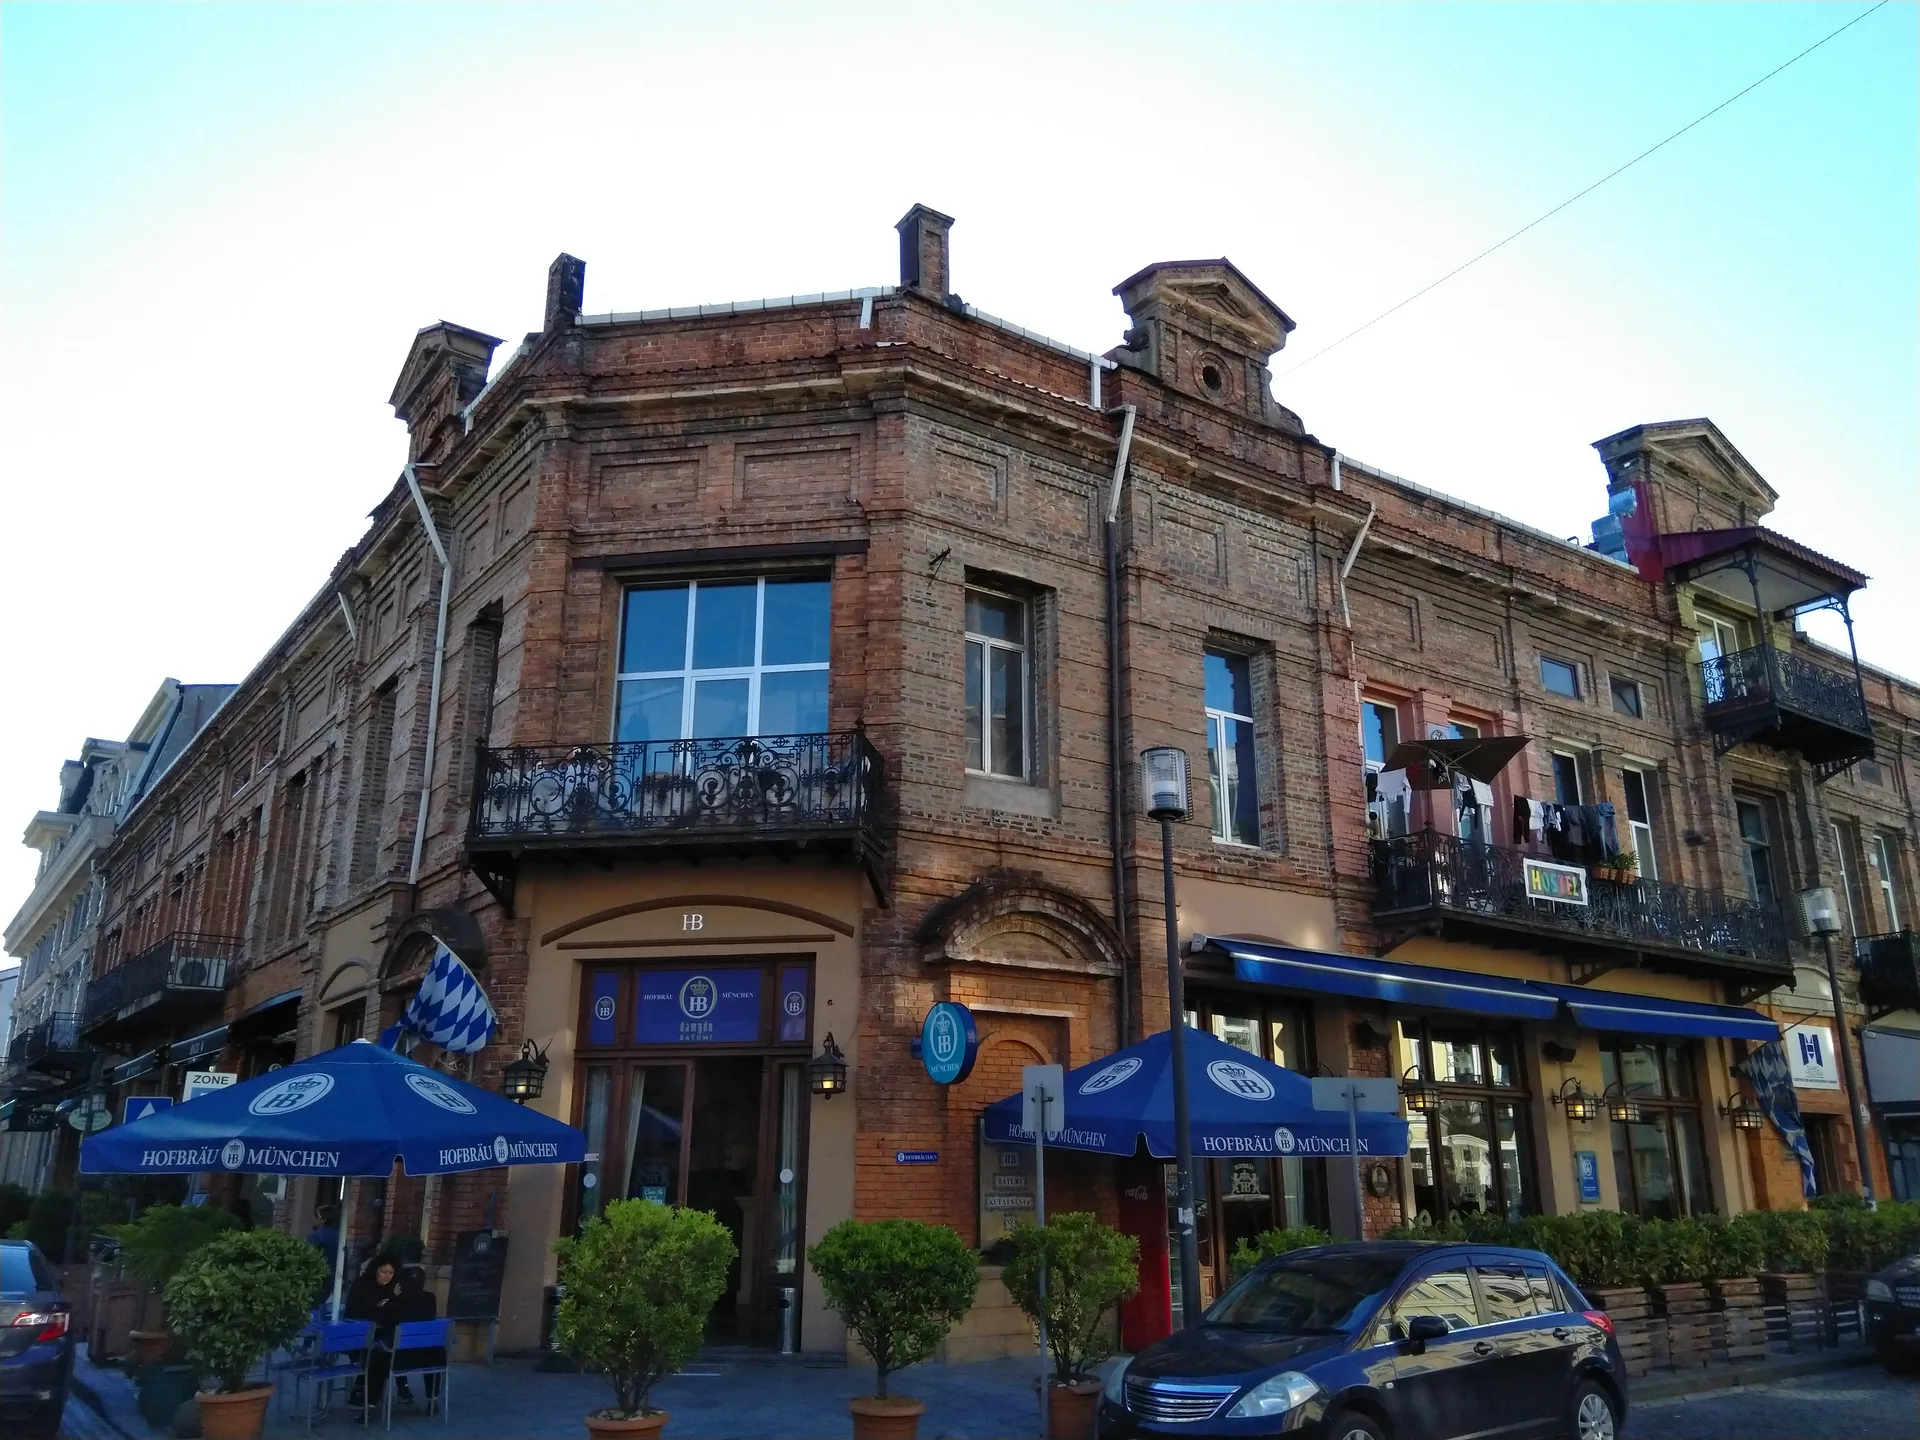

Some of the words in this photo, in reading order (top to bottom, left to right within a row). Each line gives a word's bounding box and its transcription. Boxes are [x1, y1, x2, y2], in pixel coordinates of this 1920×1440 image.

[1531, 869, 1580, 896] HOSTEL
[682, 914, 703, 931] HB
[721, 991, 754, 999] MÜNCHEN
[600, 1007, 611, 1016] HB
[688, 996, 708, 1012] HB
[789, 1002, 800, 1012] HB
[937, 1035, 951, 1054] HB
[930, 1061, 959, 1073] MÜNCHEN
[192, 1074, 230, 1085] ZONE
[1087, 1075, 1116, 1088] HB
[1230, 1079, 1264, 1094] HB
[260, 1093, 305, 1108] HB
[1058, 1127, 1107, 1147] MÜNCHEN
[1202, 1135, 1273, 1152] HOFBRÄU
[140, 1146, 220, 1166] HOFBRÄU
[247, 1146, 340, 1168] MÜNCHEN
[439, 1143, 492, 1166] HOFBRÄU
[508, 1141, 558, 1159] MÜNCHEN
